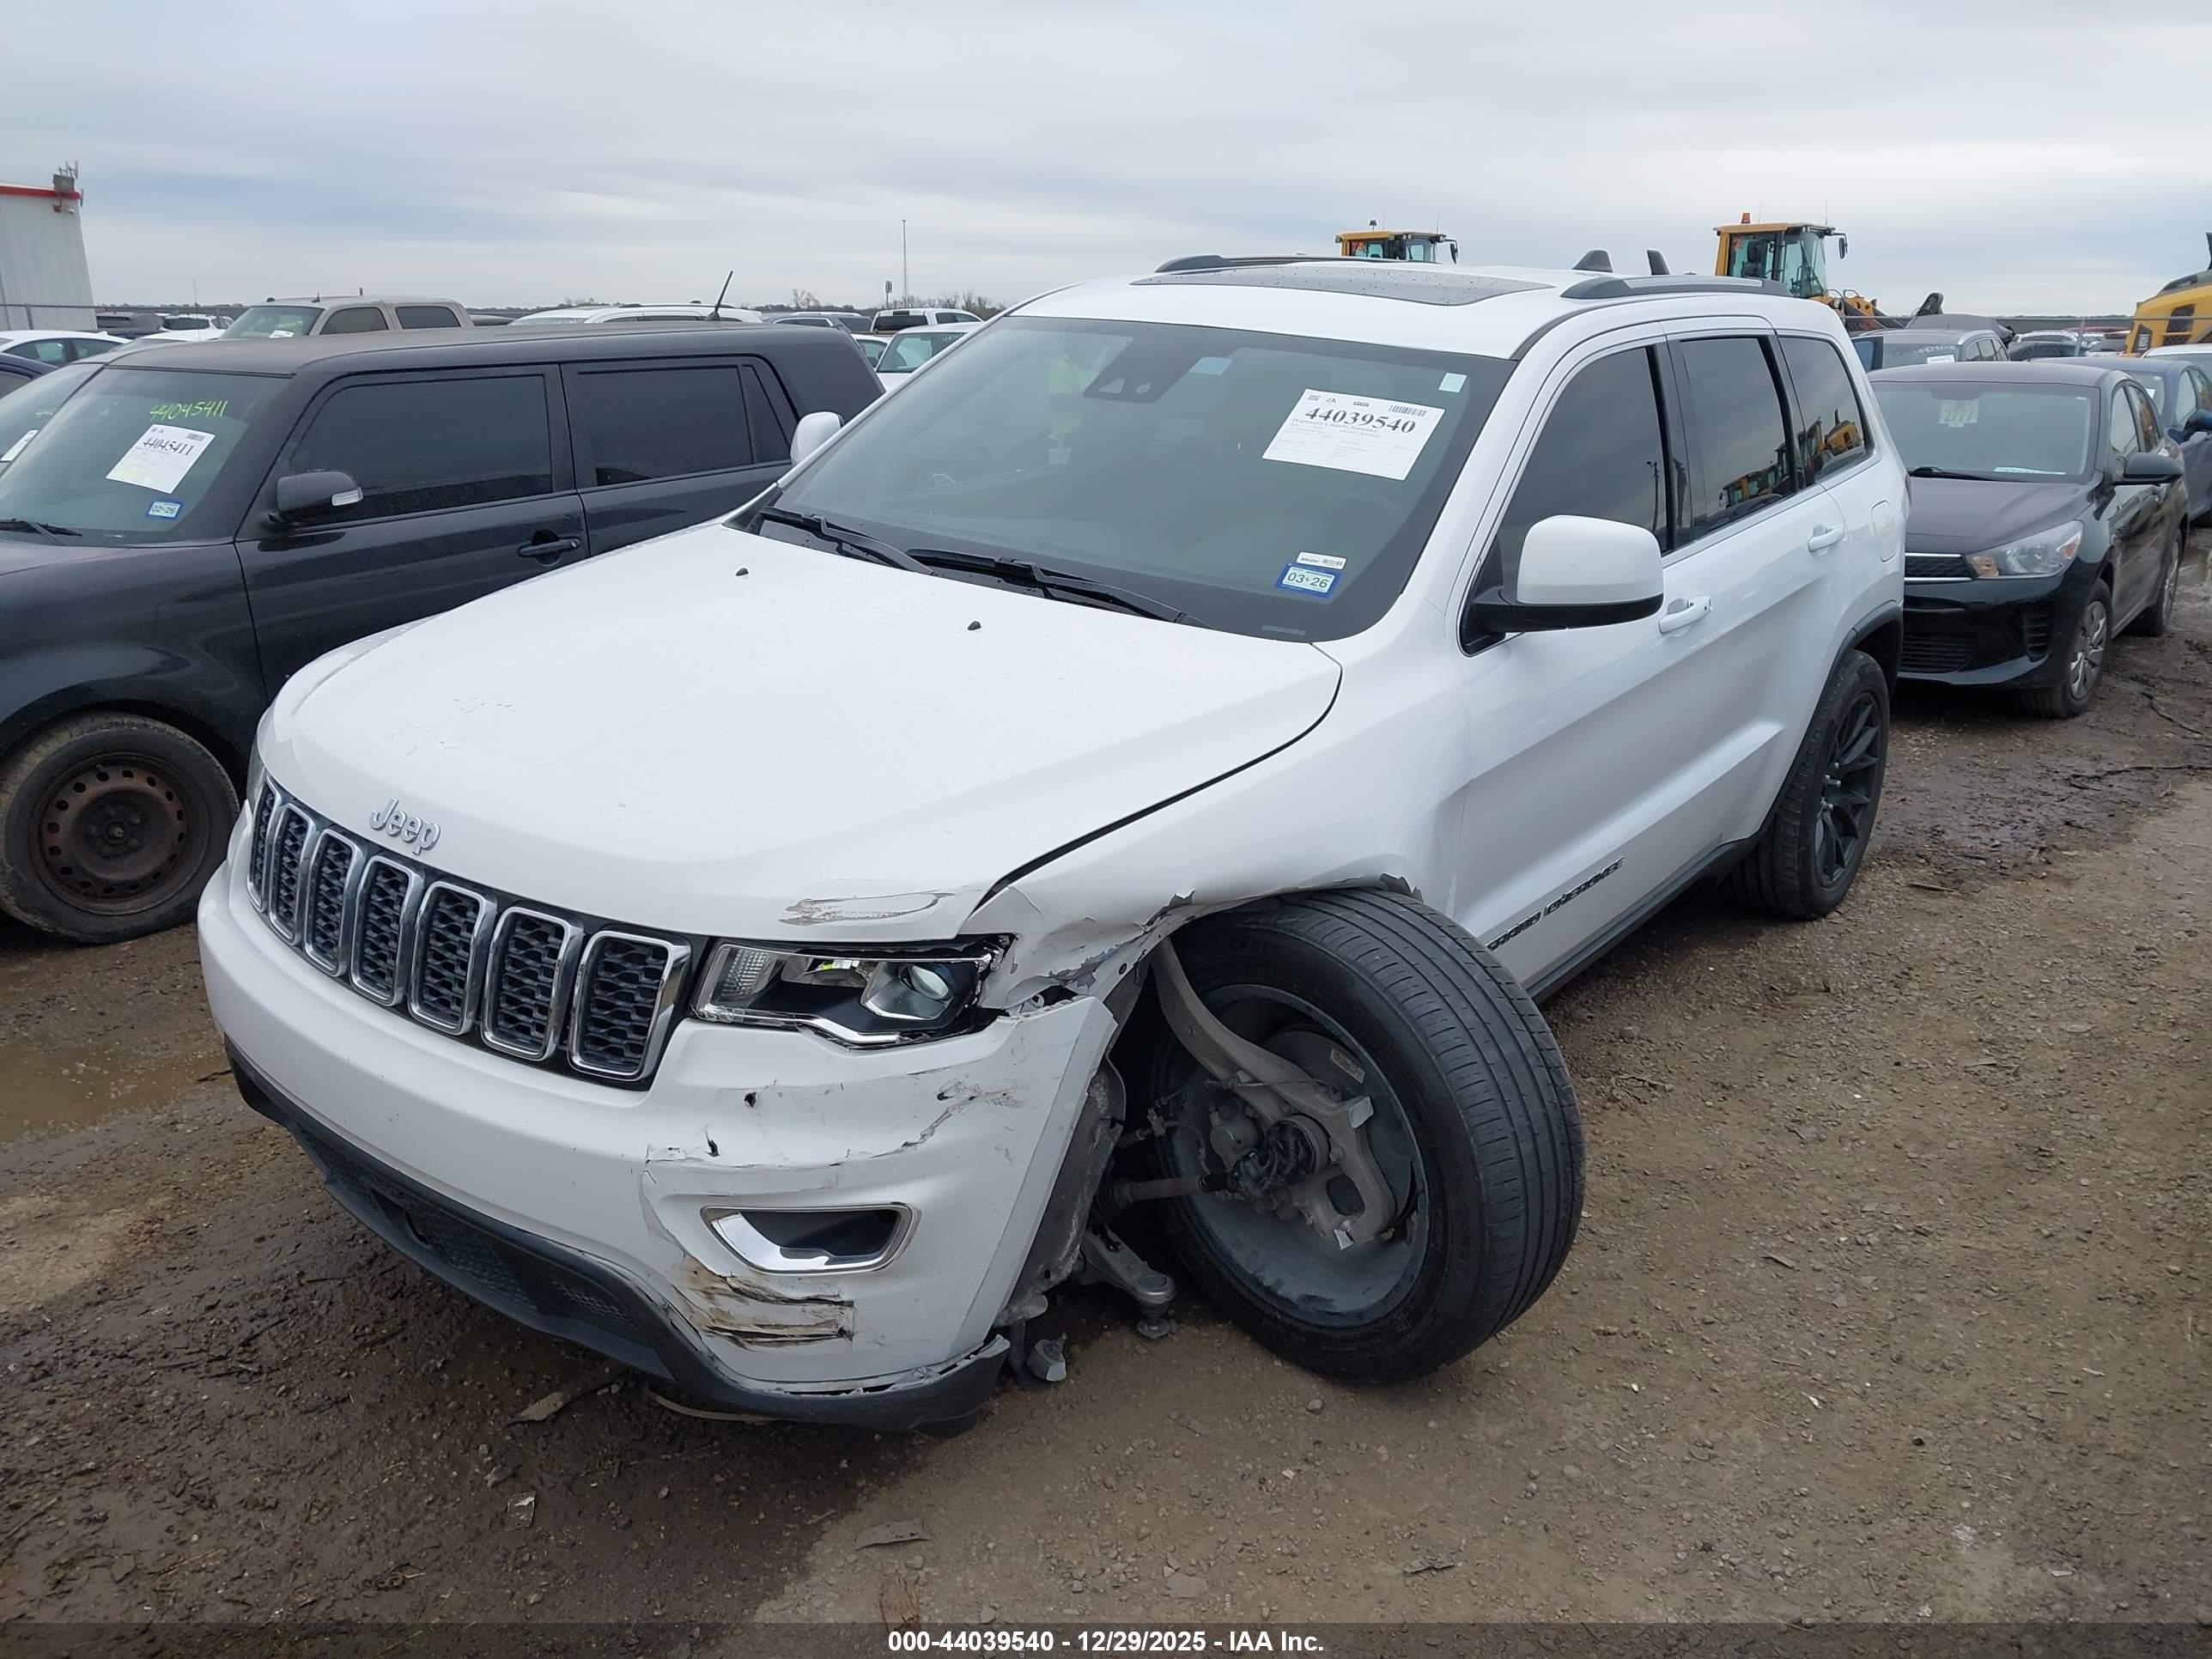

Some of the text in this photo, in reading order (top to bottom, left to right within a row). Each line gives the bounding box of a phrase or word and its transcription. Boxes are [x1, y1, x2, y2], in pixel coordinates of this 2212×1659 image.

[149, 399, 228, 422] 44045411
[1304, 407, 1417, 434] 44039540
[143, 436, 195, 456] 44045411
[369, 797, 441, 857] Jeep
[1544, 856, 1626, 916] CHEROKEE
